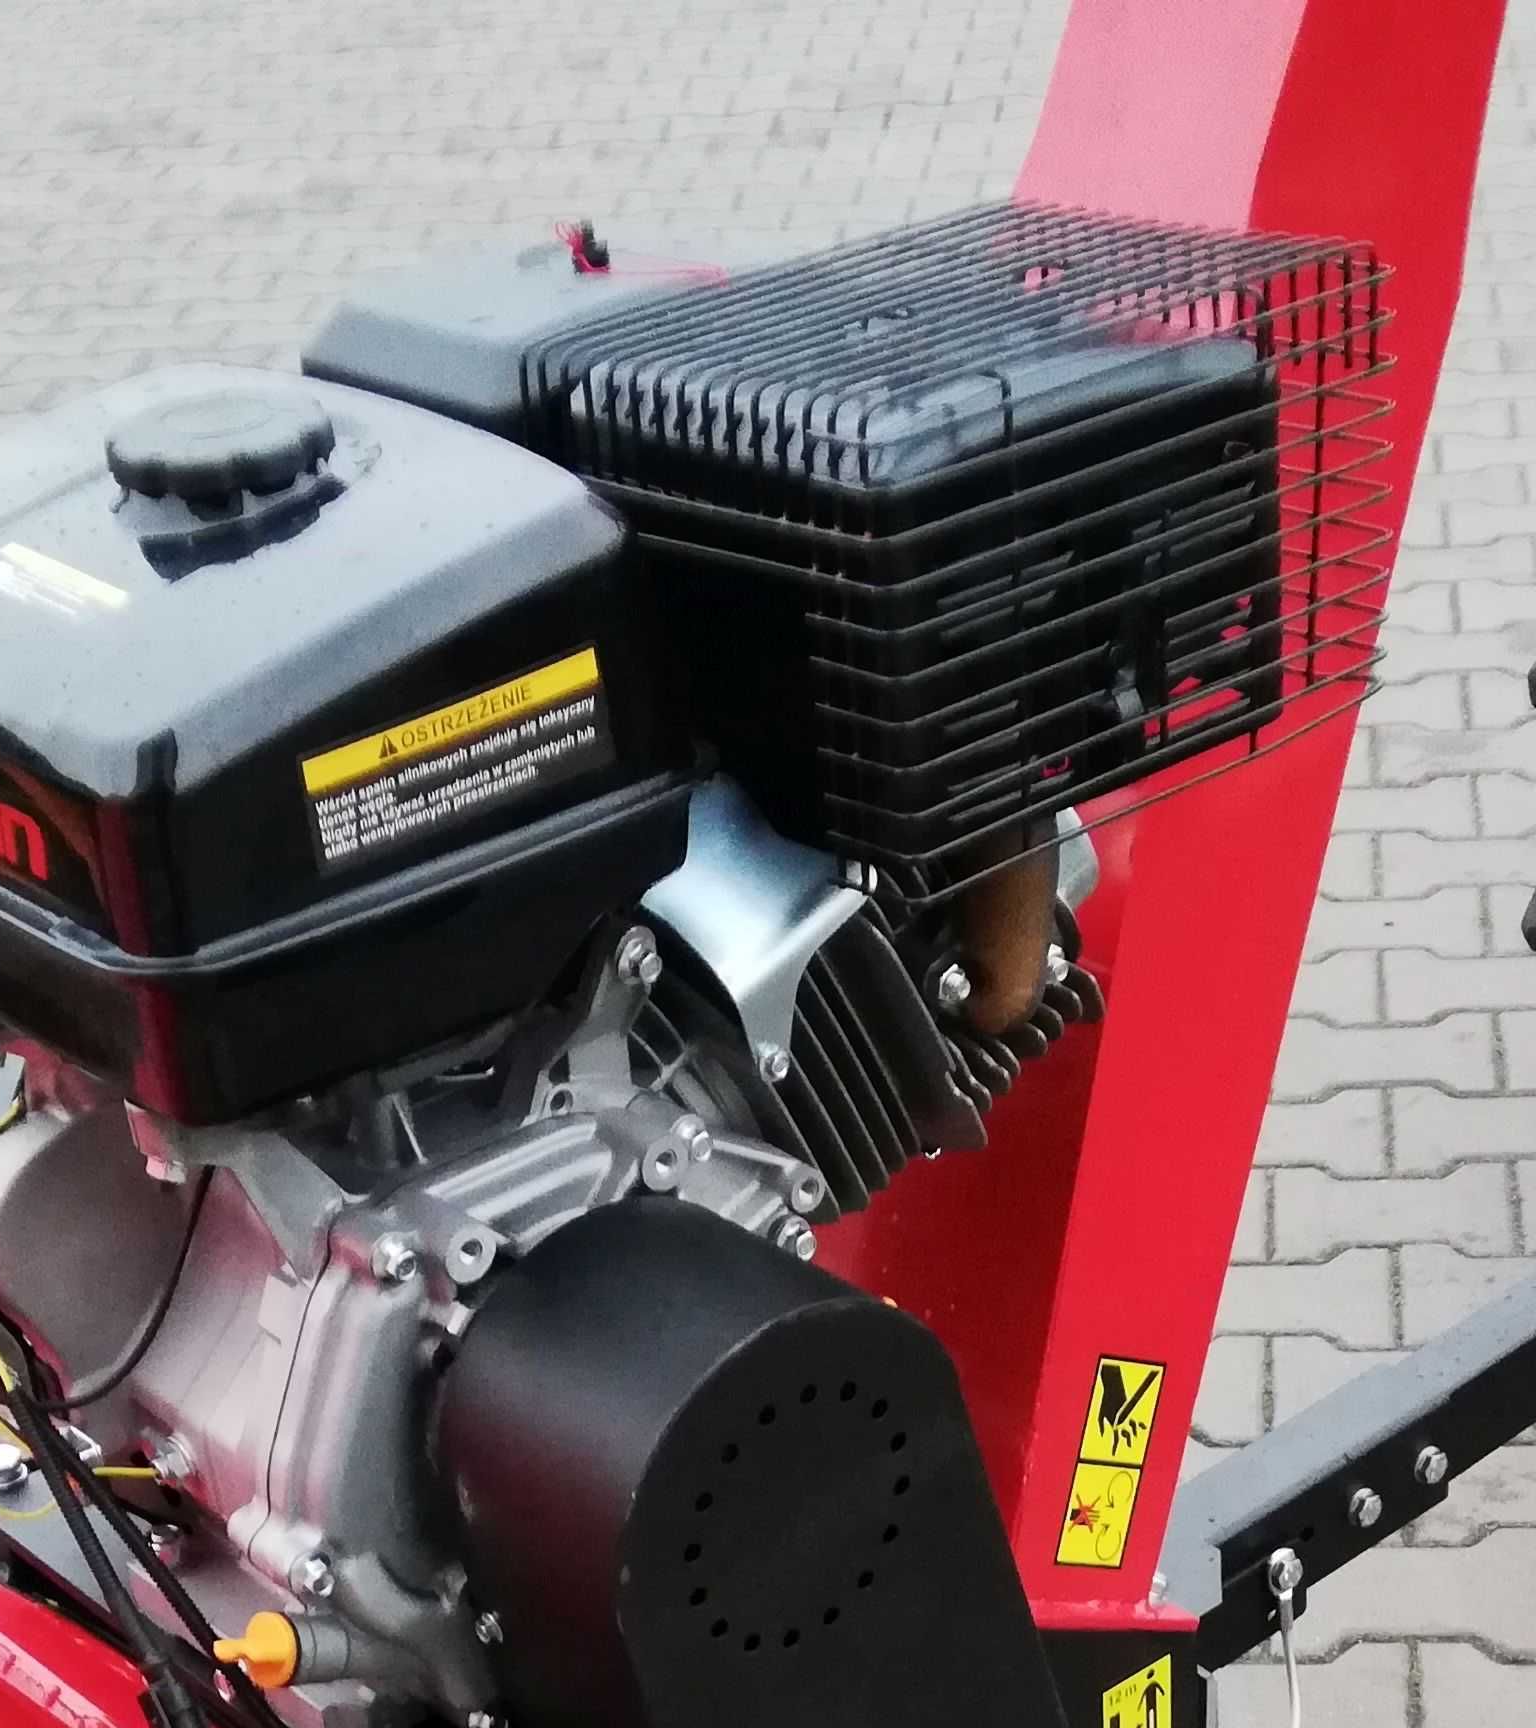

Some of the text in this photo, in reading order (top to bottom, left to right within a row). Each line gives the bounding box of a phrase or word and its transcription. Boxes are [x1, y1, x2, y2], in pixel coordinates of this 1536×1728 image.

[398, 747, 468, 787] silnikowych
[539, 695, 595, 729] toksyczny
[401, 682, 531, 748] OSTRZEŻENIE
[492, 763, 503, 778] w
[577, 725, 595, 744] lub
